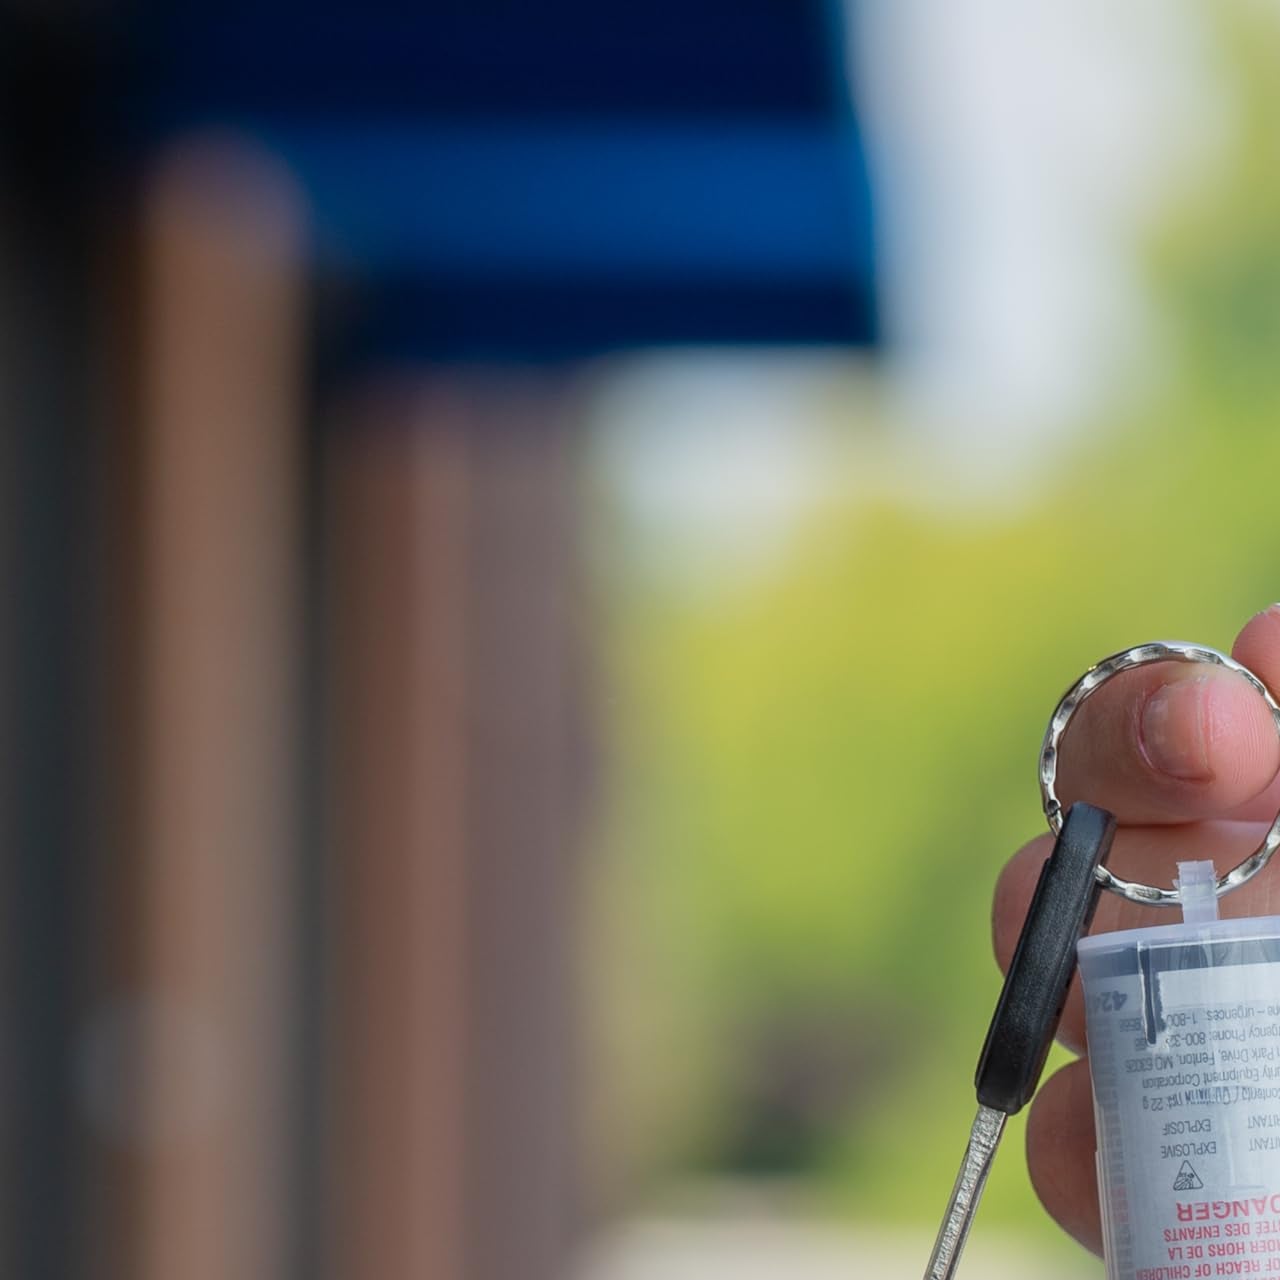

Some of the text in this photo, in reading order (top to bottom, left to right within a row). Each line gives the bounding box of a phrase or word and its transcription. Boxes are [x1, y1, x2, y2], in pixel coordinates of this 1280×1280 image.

[1210, 1029, 1246, 1043] Phone:
[1177, 1051, 1215, 1067] Fenton,
[1252, 1047, 1274, 1061] Park
[1155, 1056, 1173, 1070] MO
[1142, 1072, 1200, 1088] Corporation
[1204, 1067, 1259, 1085] Equipment
[1142, 1096, 1148, 1110] g
[1151, 1098, 1163, 1111] 22
[1162, 1119, 1211, 1135] EXPLOSIF
[1161, 1141, 1216, 1159] EXPLOSIVE
[1163, 1225, 1220, 1242] ENFANTS
[1225, 1223, 1249, 1237] DES
[1168, 1247, 1182, 1260] LA
[1187, 1245, 1203, 1259] DE
[1208, 1242, 1245, 1257] HORS
[1195, 1264, 1211, 1277] OF
[1216, 1260, 1259, 1275] REACH
[1266, 1258, 1280, 1271] OF
